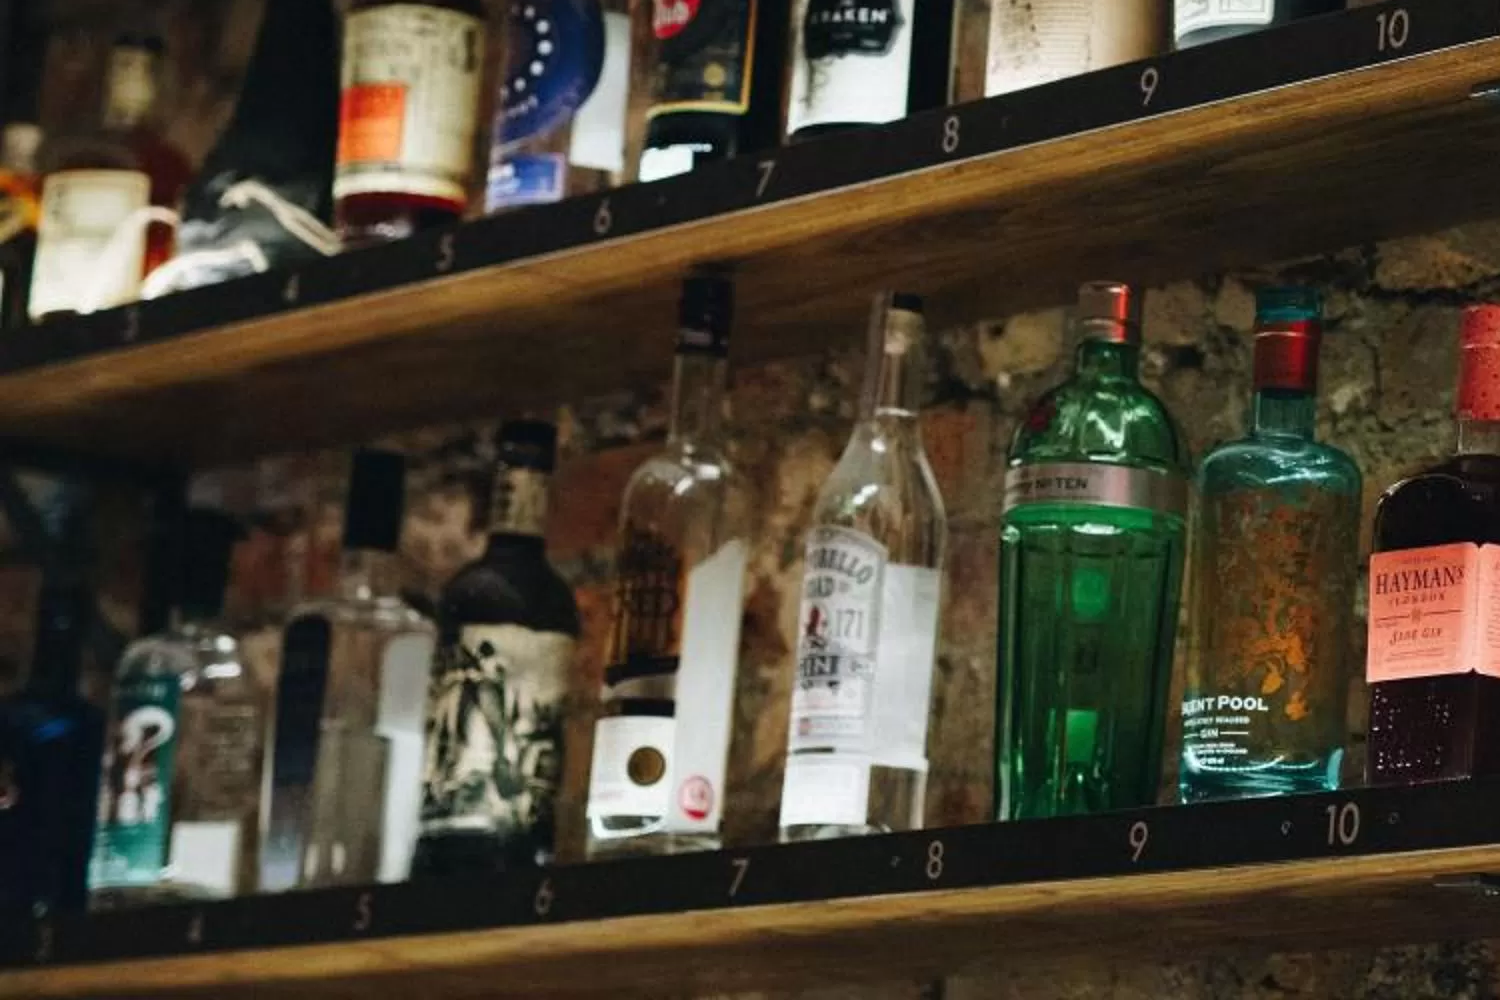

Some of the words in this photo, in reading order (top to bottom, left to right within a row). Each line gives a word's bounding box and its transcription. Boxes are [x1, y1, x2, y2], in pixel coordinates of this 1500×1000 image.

[1376, 8, 1413, 51] 10
[1140, 67, 1159, 105] 9
[942, 115, 960, 153] 8
[757, 160, 776, 196] 7
[1055, 477, 1088, 489] TEN
[1217, 695, 1269, 711] POOL
[1130, 821, 1149, 862] 9
[1326, 801, 1360, 845] 10
[730, 858, 750, 896] 7
[926, 840, 944, 880] 8
[535, 880, 553, 915] 6
